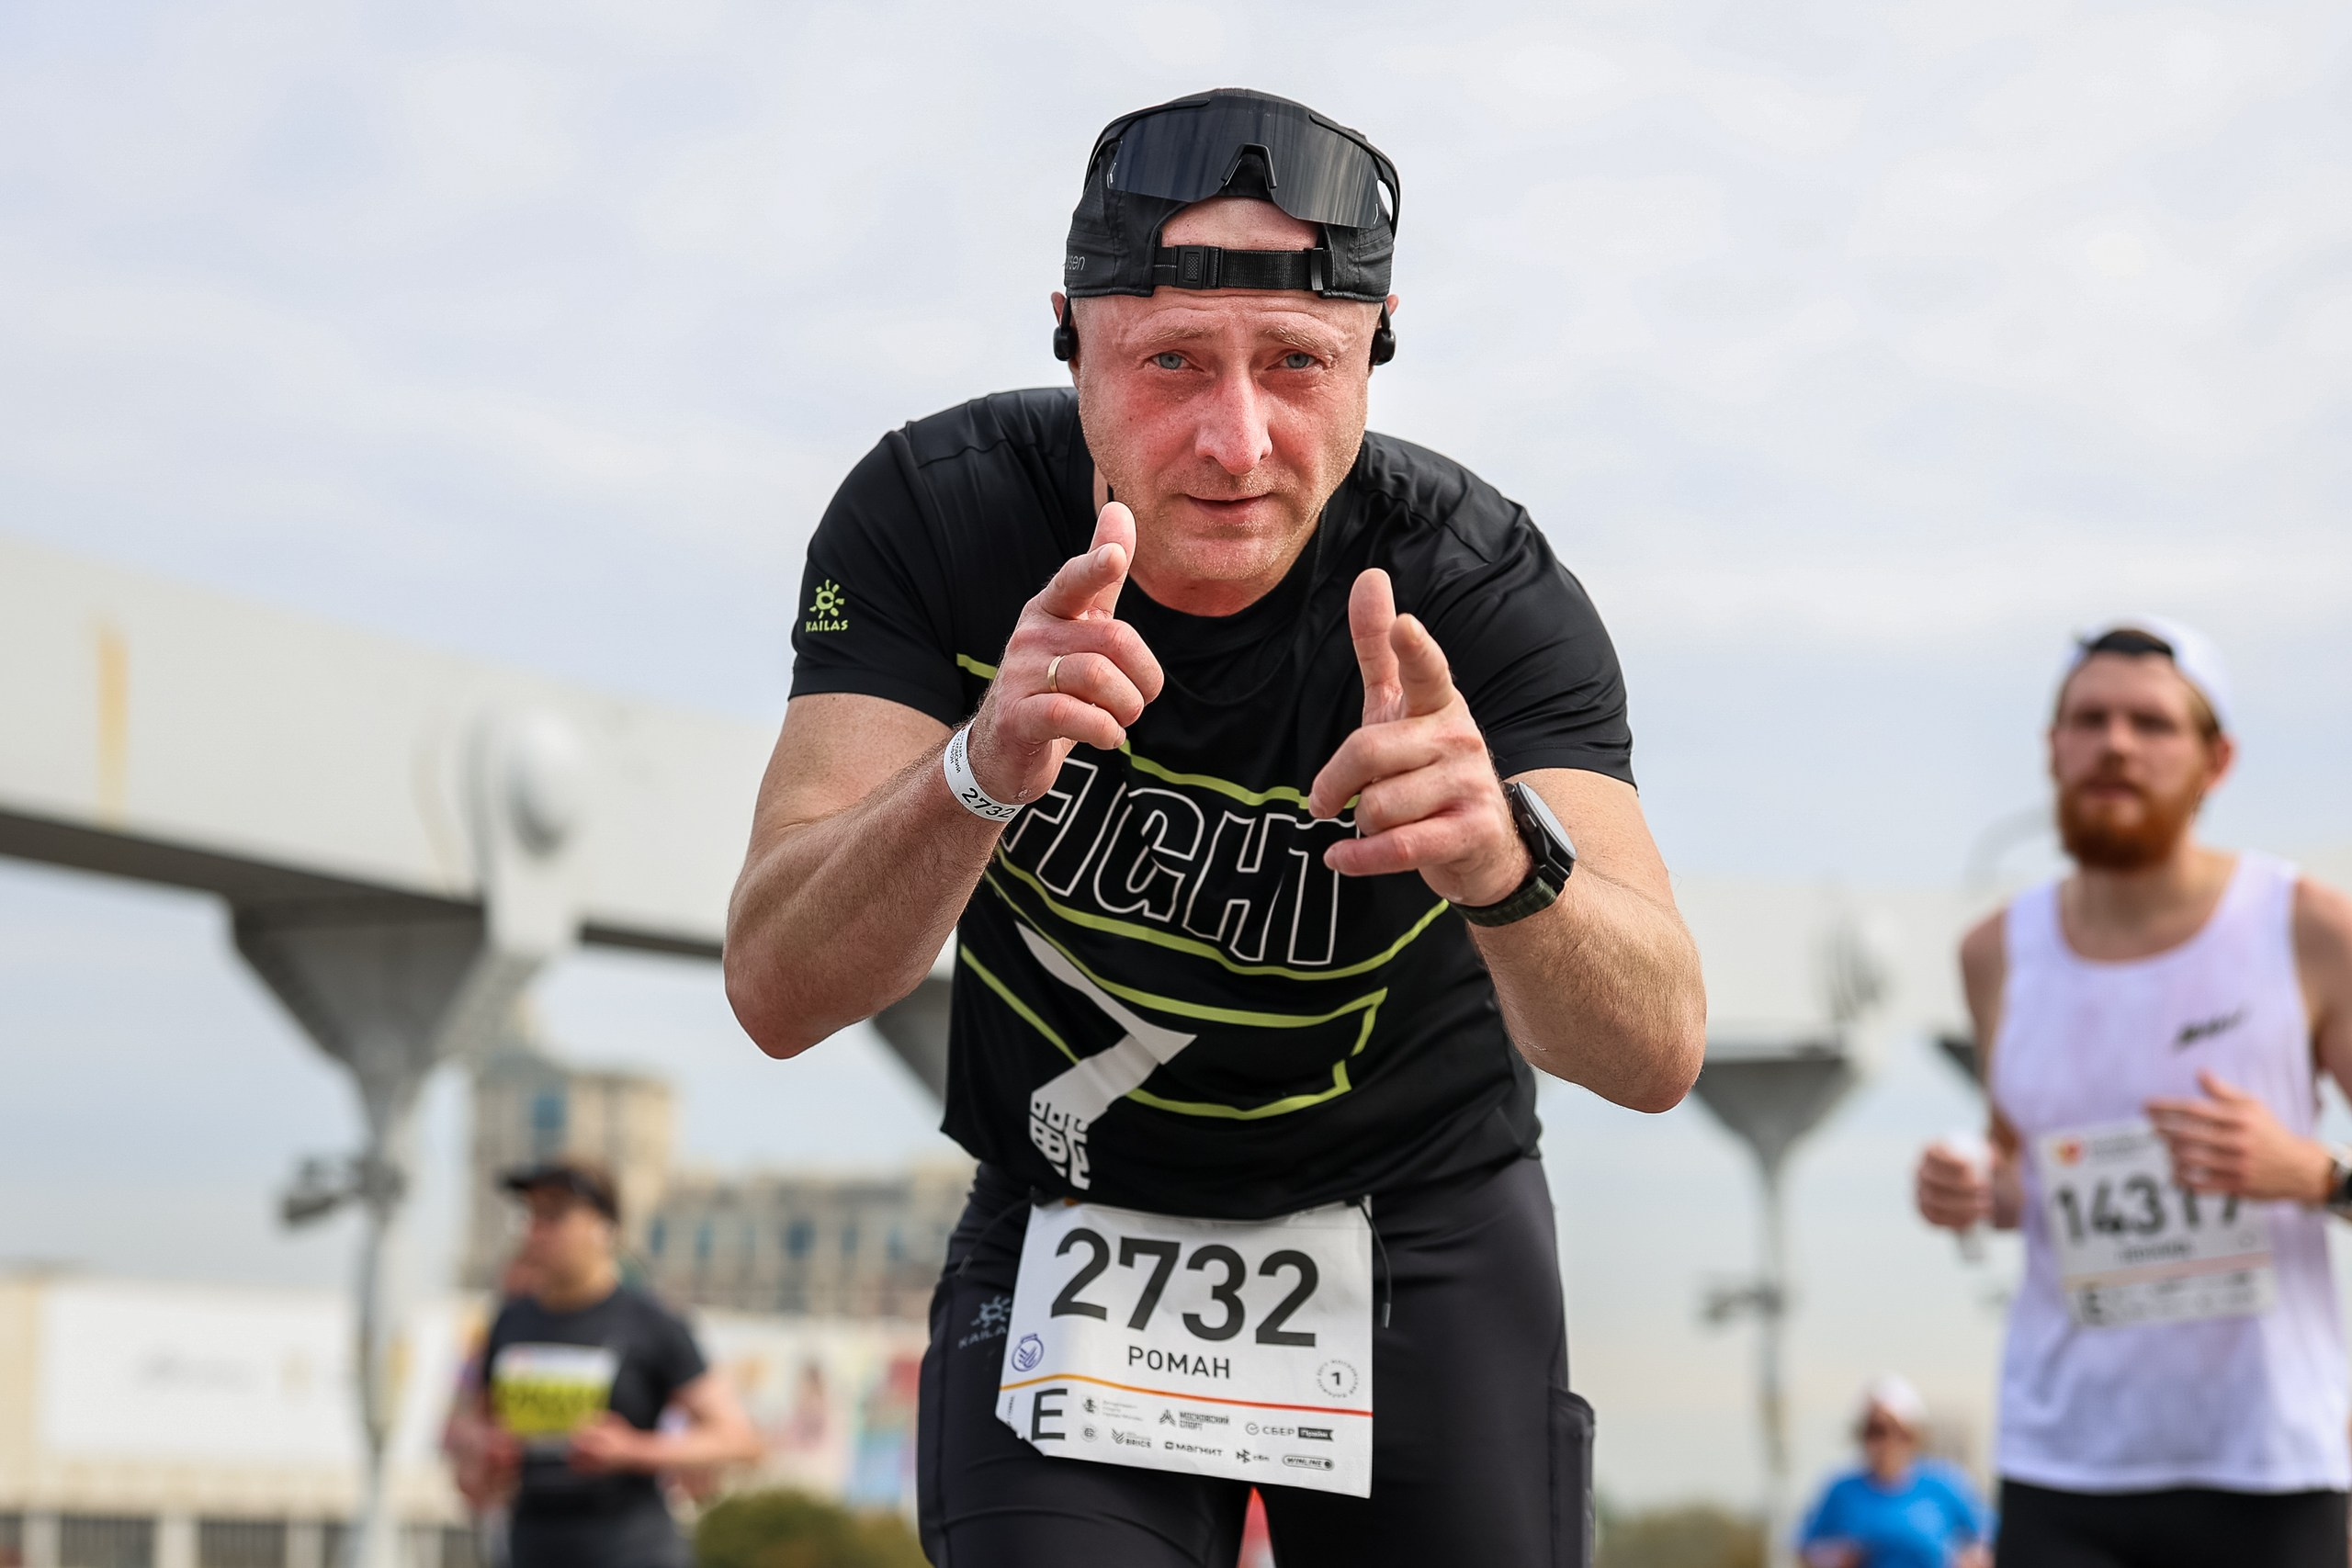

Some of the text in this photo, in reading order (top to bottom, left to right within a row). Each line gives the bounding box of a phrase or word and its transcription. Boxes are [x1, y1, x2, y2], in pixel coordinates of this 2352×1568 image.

[805, 619, 849, 633] KAILAS
[961, 787, 1016, 818] 2732
[1001, 757, 1361, 965] FIGHT
[1050, 1228, 1320, 1348] 2732
[1127, 1346, 1231, 1380] РОМАН
[1331, 1371, 1340, 1386] 1
[1031, 1388, 1069, 1441] E
[1262, 1426, 1295, 1437] СБЕР
